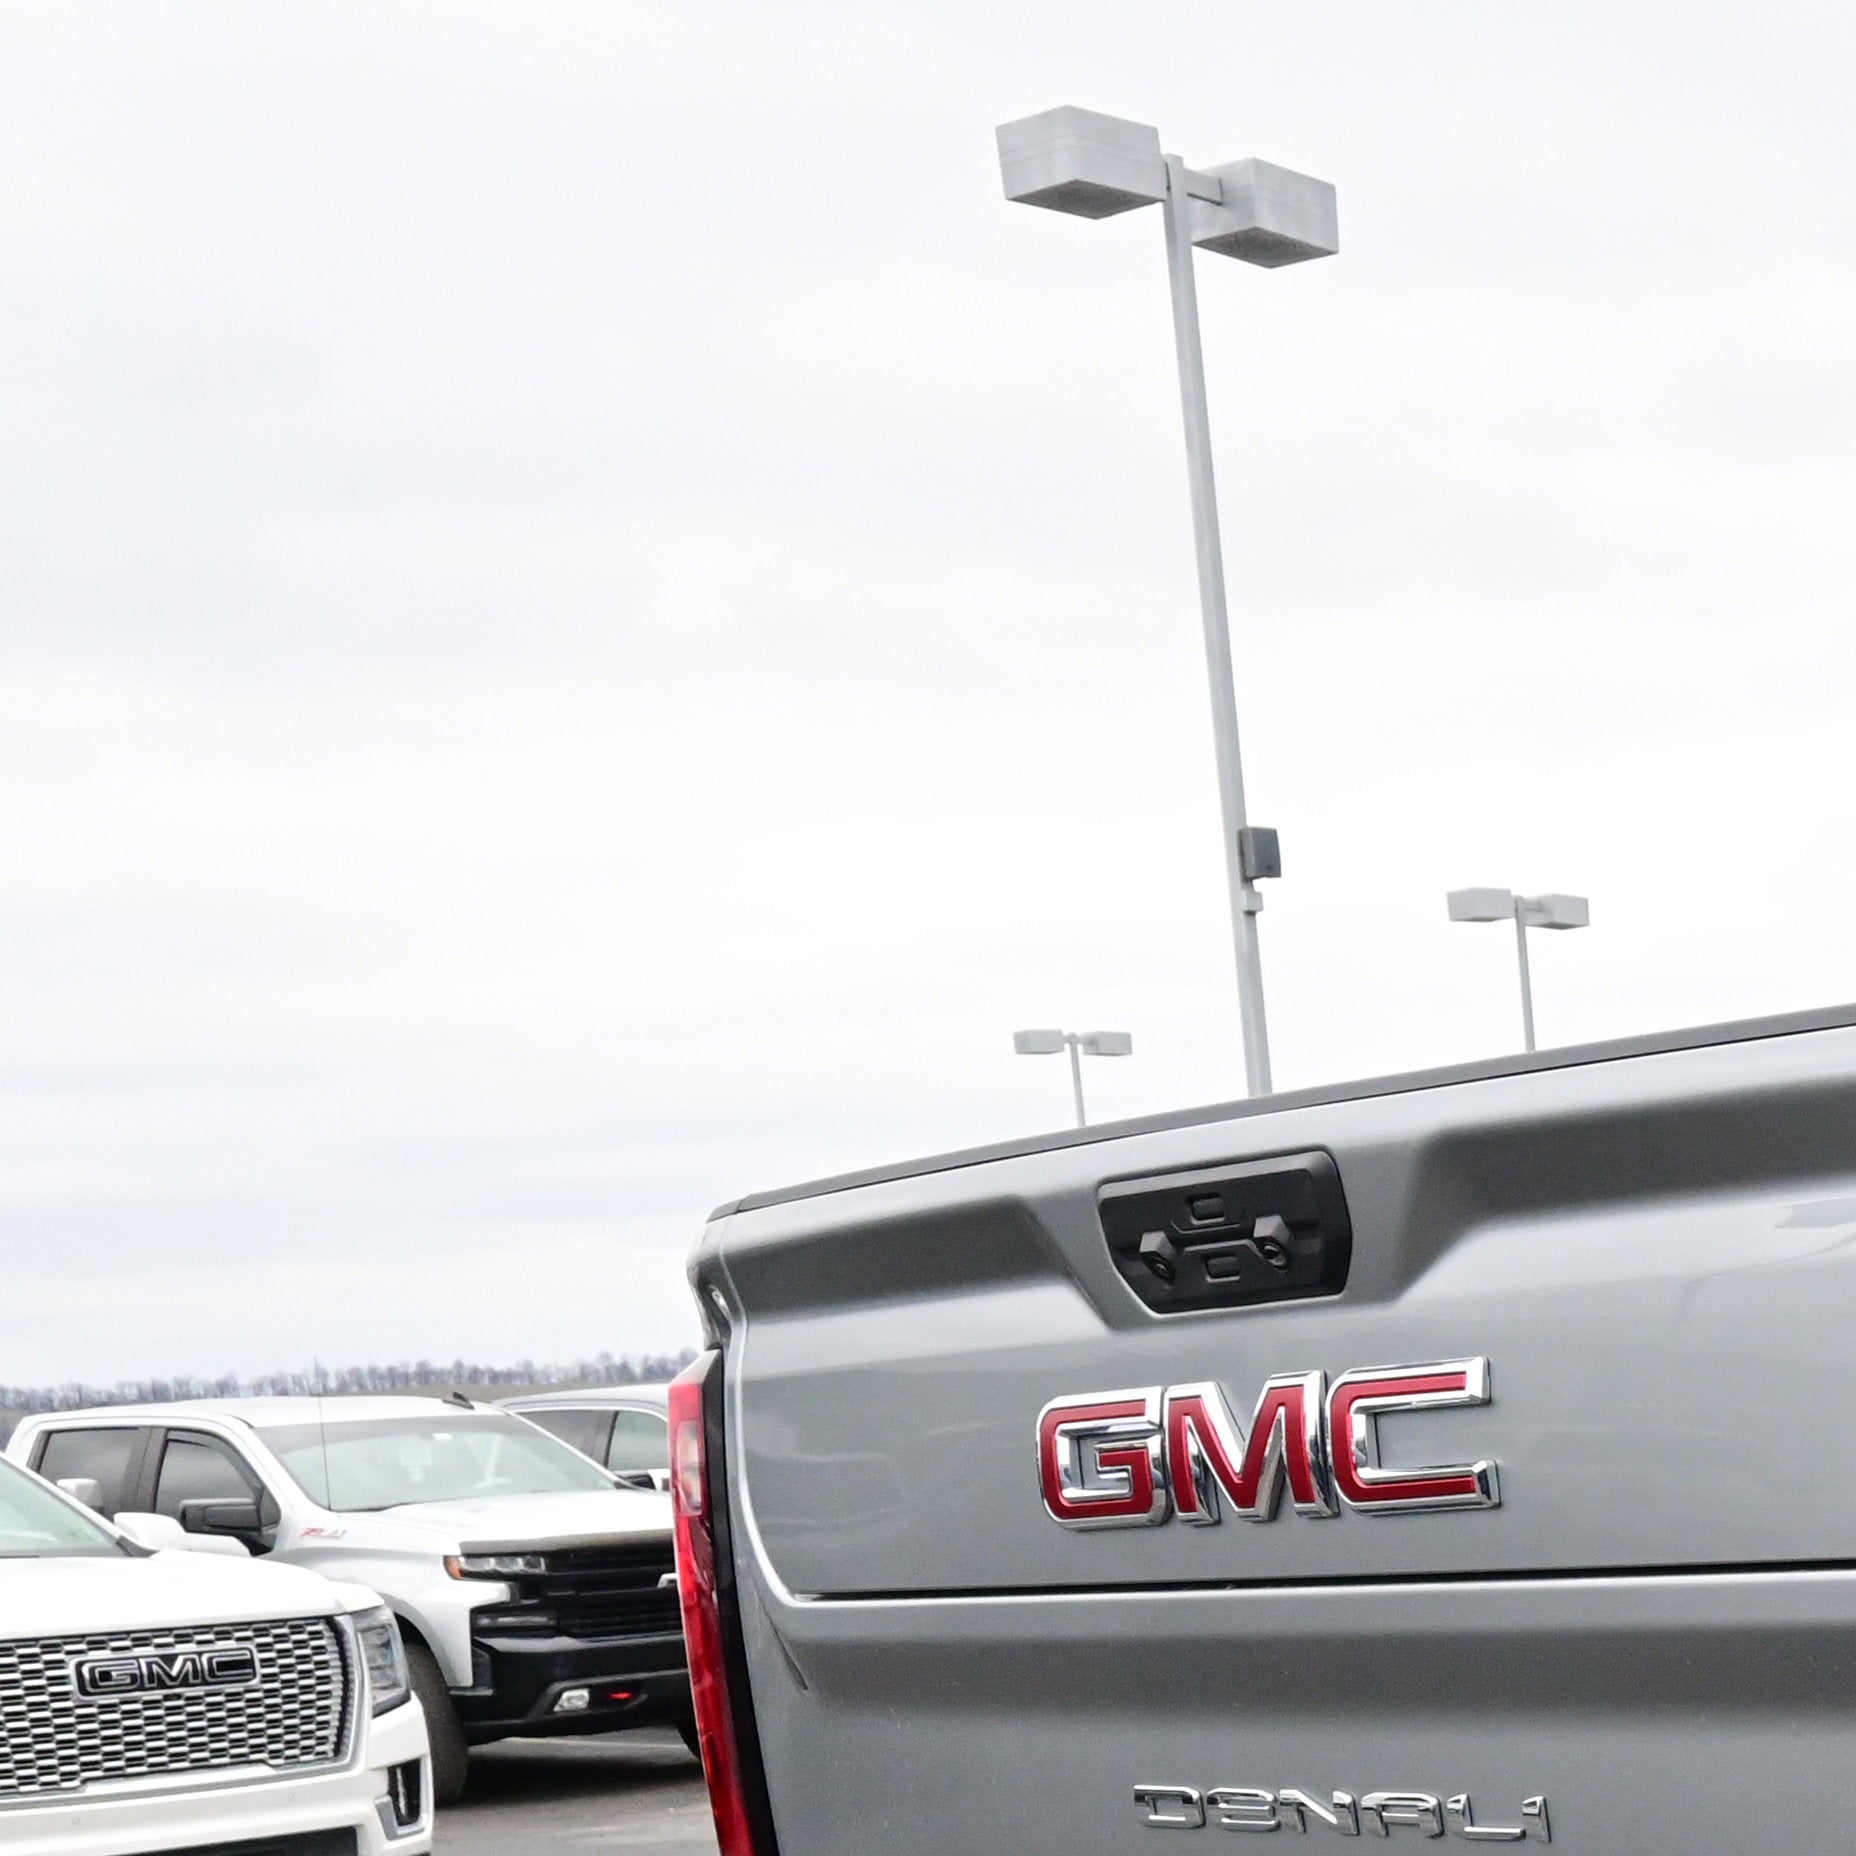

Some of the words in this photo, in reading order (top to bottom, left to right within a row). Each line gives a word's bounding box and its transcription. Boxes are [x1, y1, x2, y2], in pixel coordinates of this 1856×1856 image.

[1035, 1355, 1503, 1531] GMC
[82, 1649, 257, 1694] GMC
[1131, 1782, 1555, 1845] DENALI
